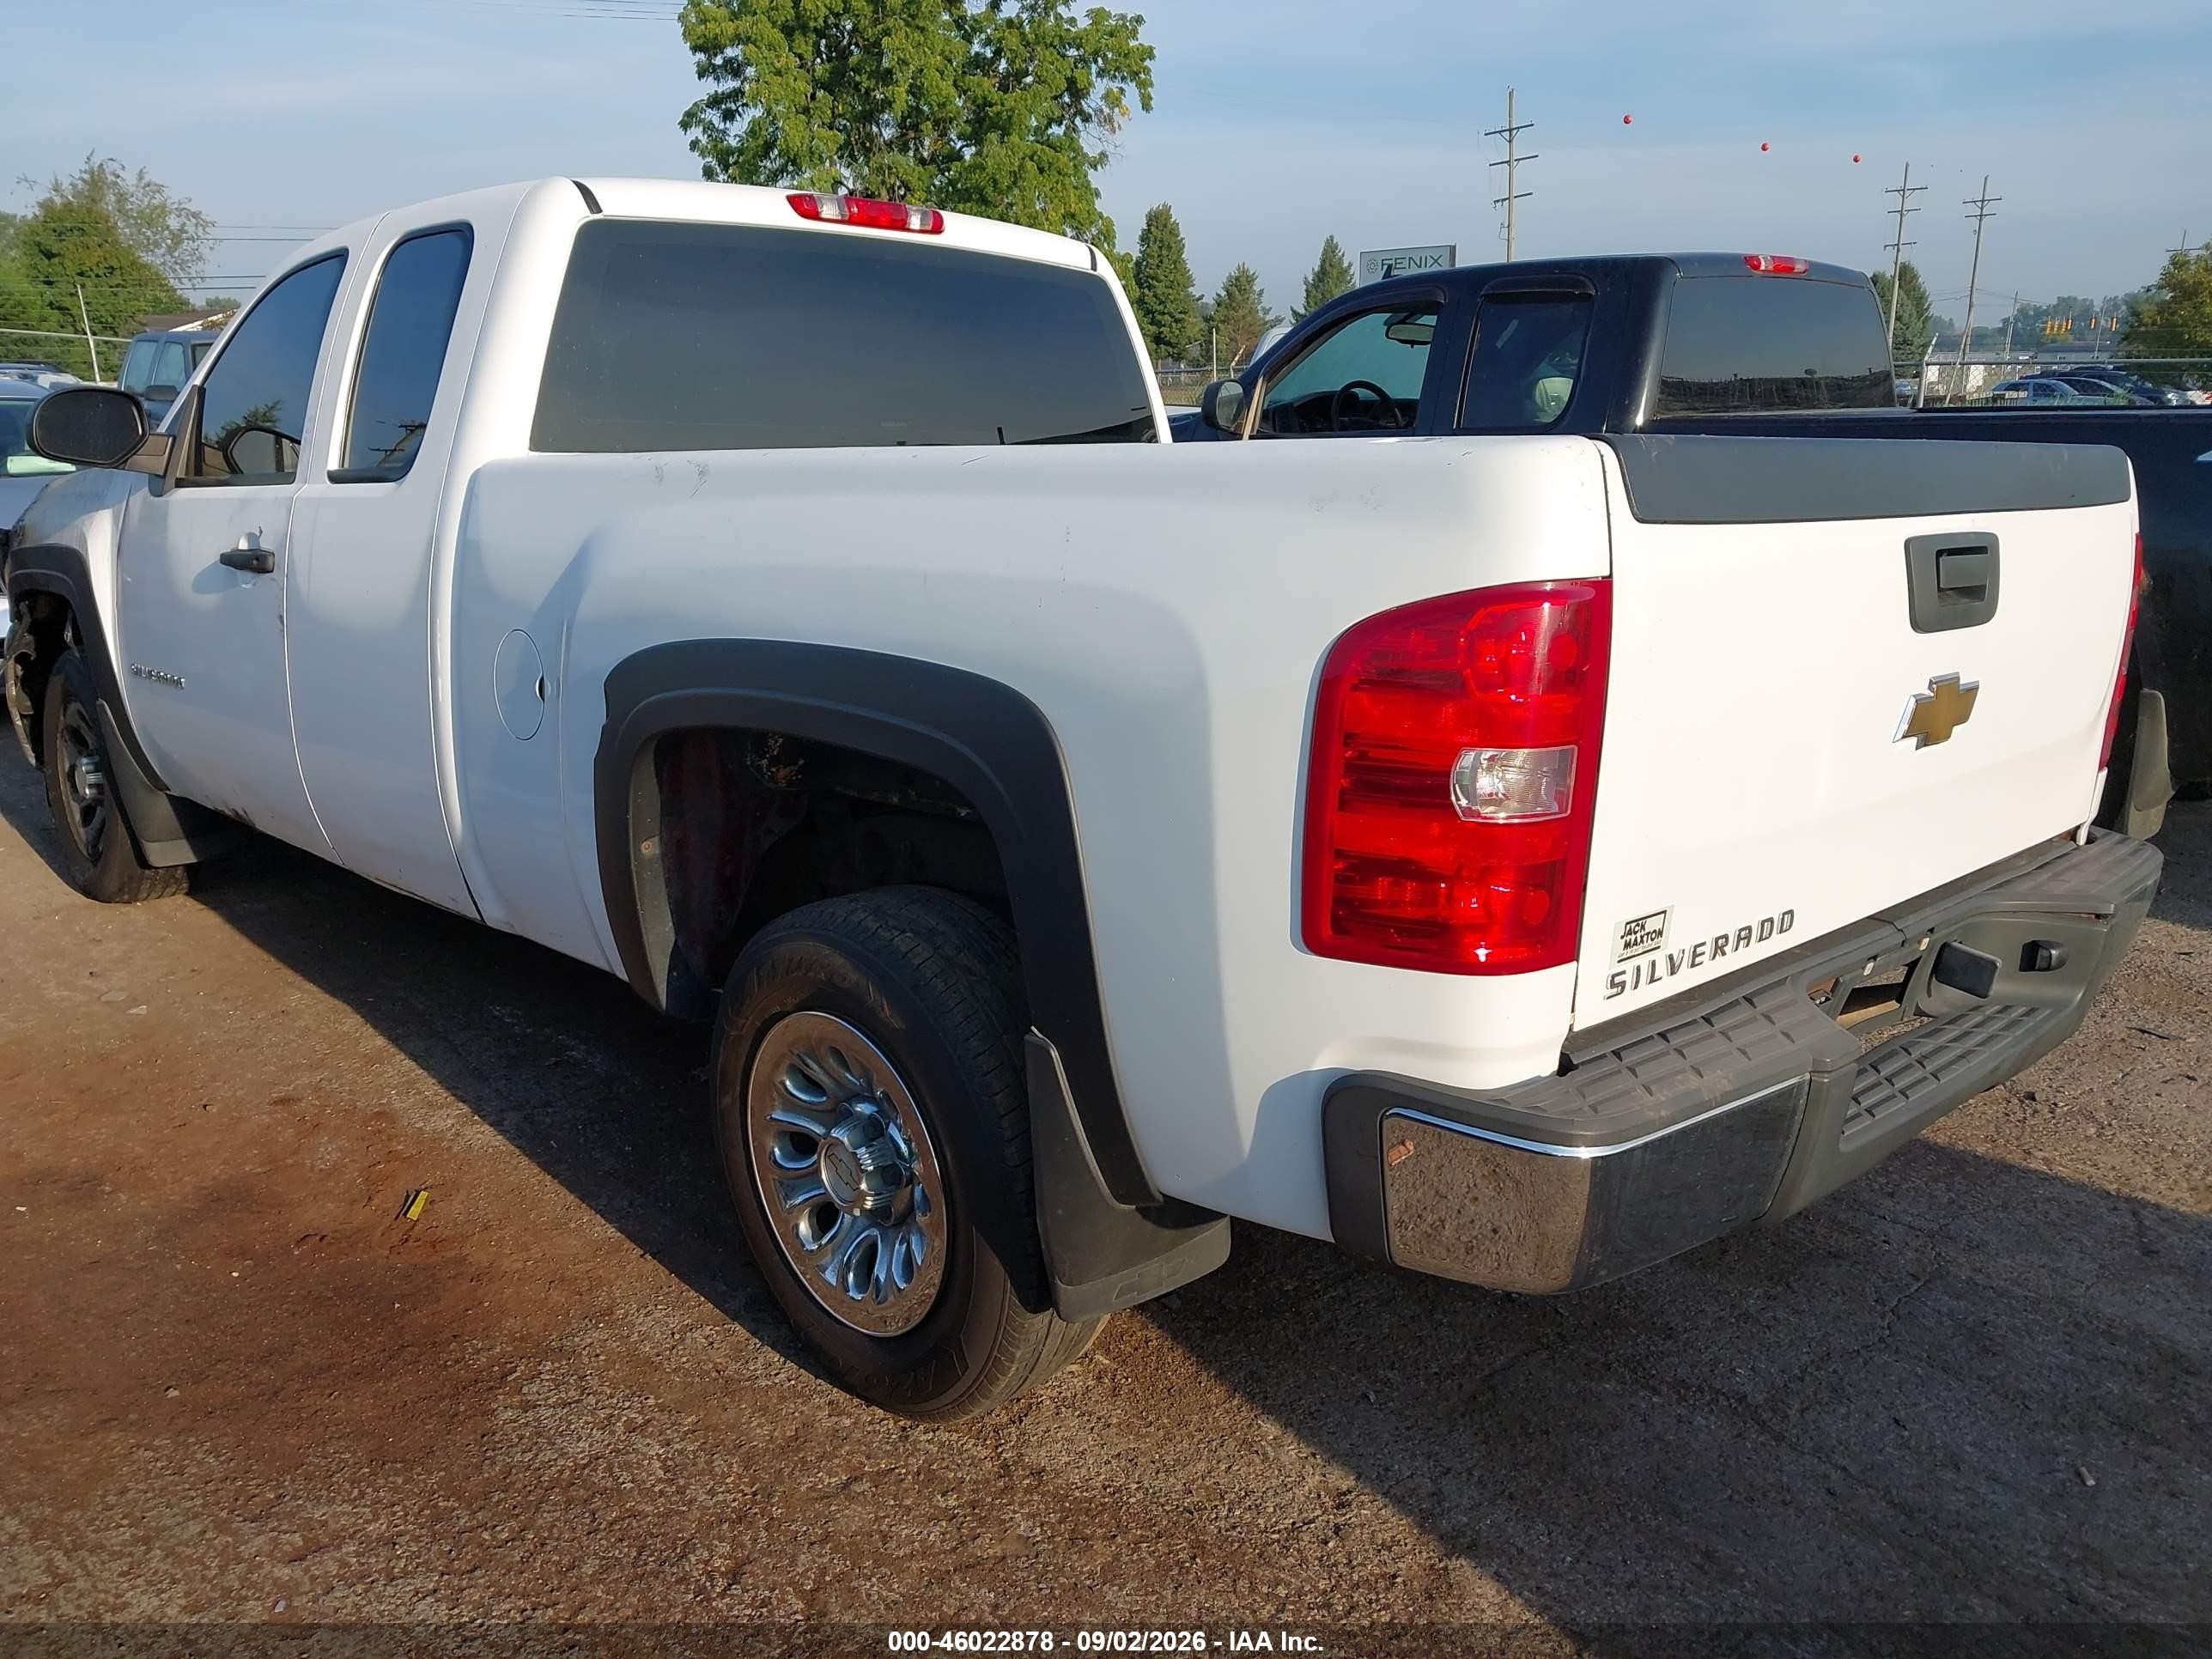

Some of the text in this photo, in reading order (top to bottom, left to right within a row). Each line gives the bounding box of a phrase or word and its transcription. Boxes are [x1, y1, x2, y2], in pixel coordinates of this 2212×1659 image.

[1381, 254, 1443, 271] FENIX
[1620, 920, 1648, 940] JACK
[1622, 927, 1663, 951] MAXTON
[1603, 908, 1795, 1000] SILVERADO
